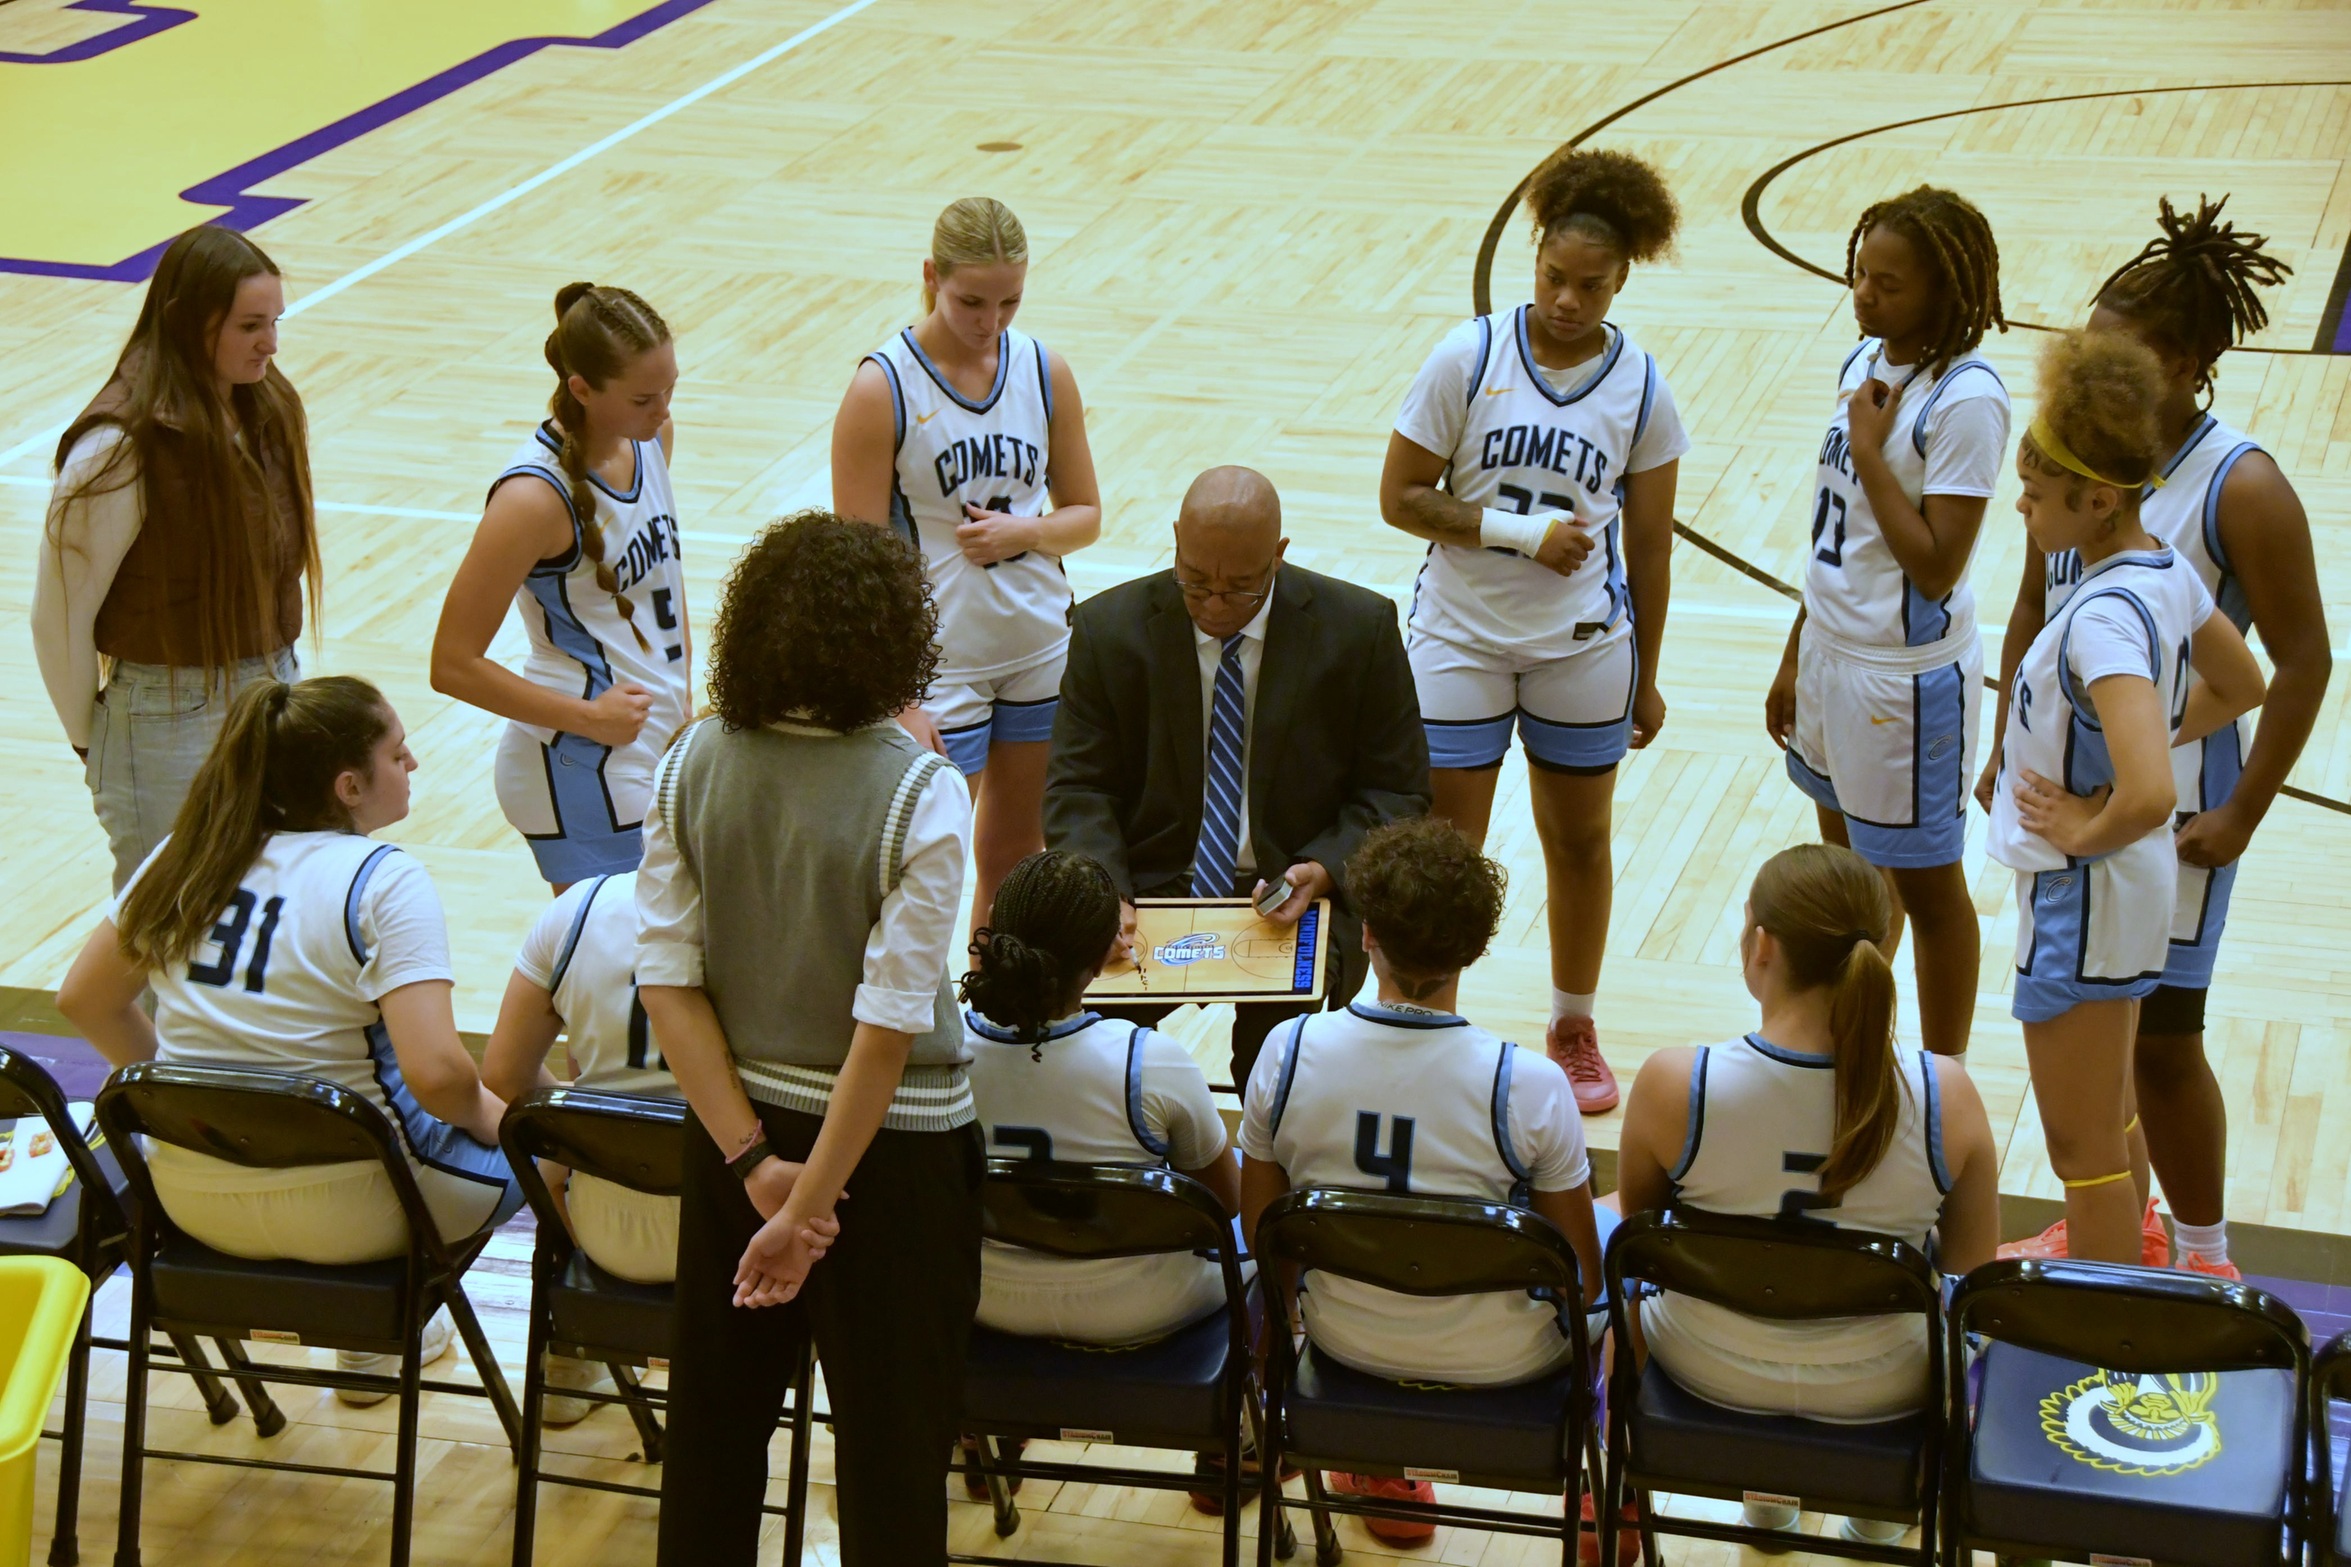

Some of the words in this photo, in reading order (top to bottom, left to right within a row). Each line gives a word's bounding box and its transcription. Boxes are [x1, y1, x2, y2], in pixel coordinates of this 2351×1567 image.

[934, 434, 1039, 498] COMETS
[1481, 425, 1608, 494] COMETS
[612, 513, 681, 598] COMETS
[184, 886, 287, 995] 31
[1153, 945, 1226, 960] COMETS
[1294, 910, 1318, 988] MINDFULNESS
[1377, 1001, 1405, 1013] NIKE
[1353, 1110, 1416, 1191] 4
